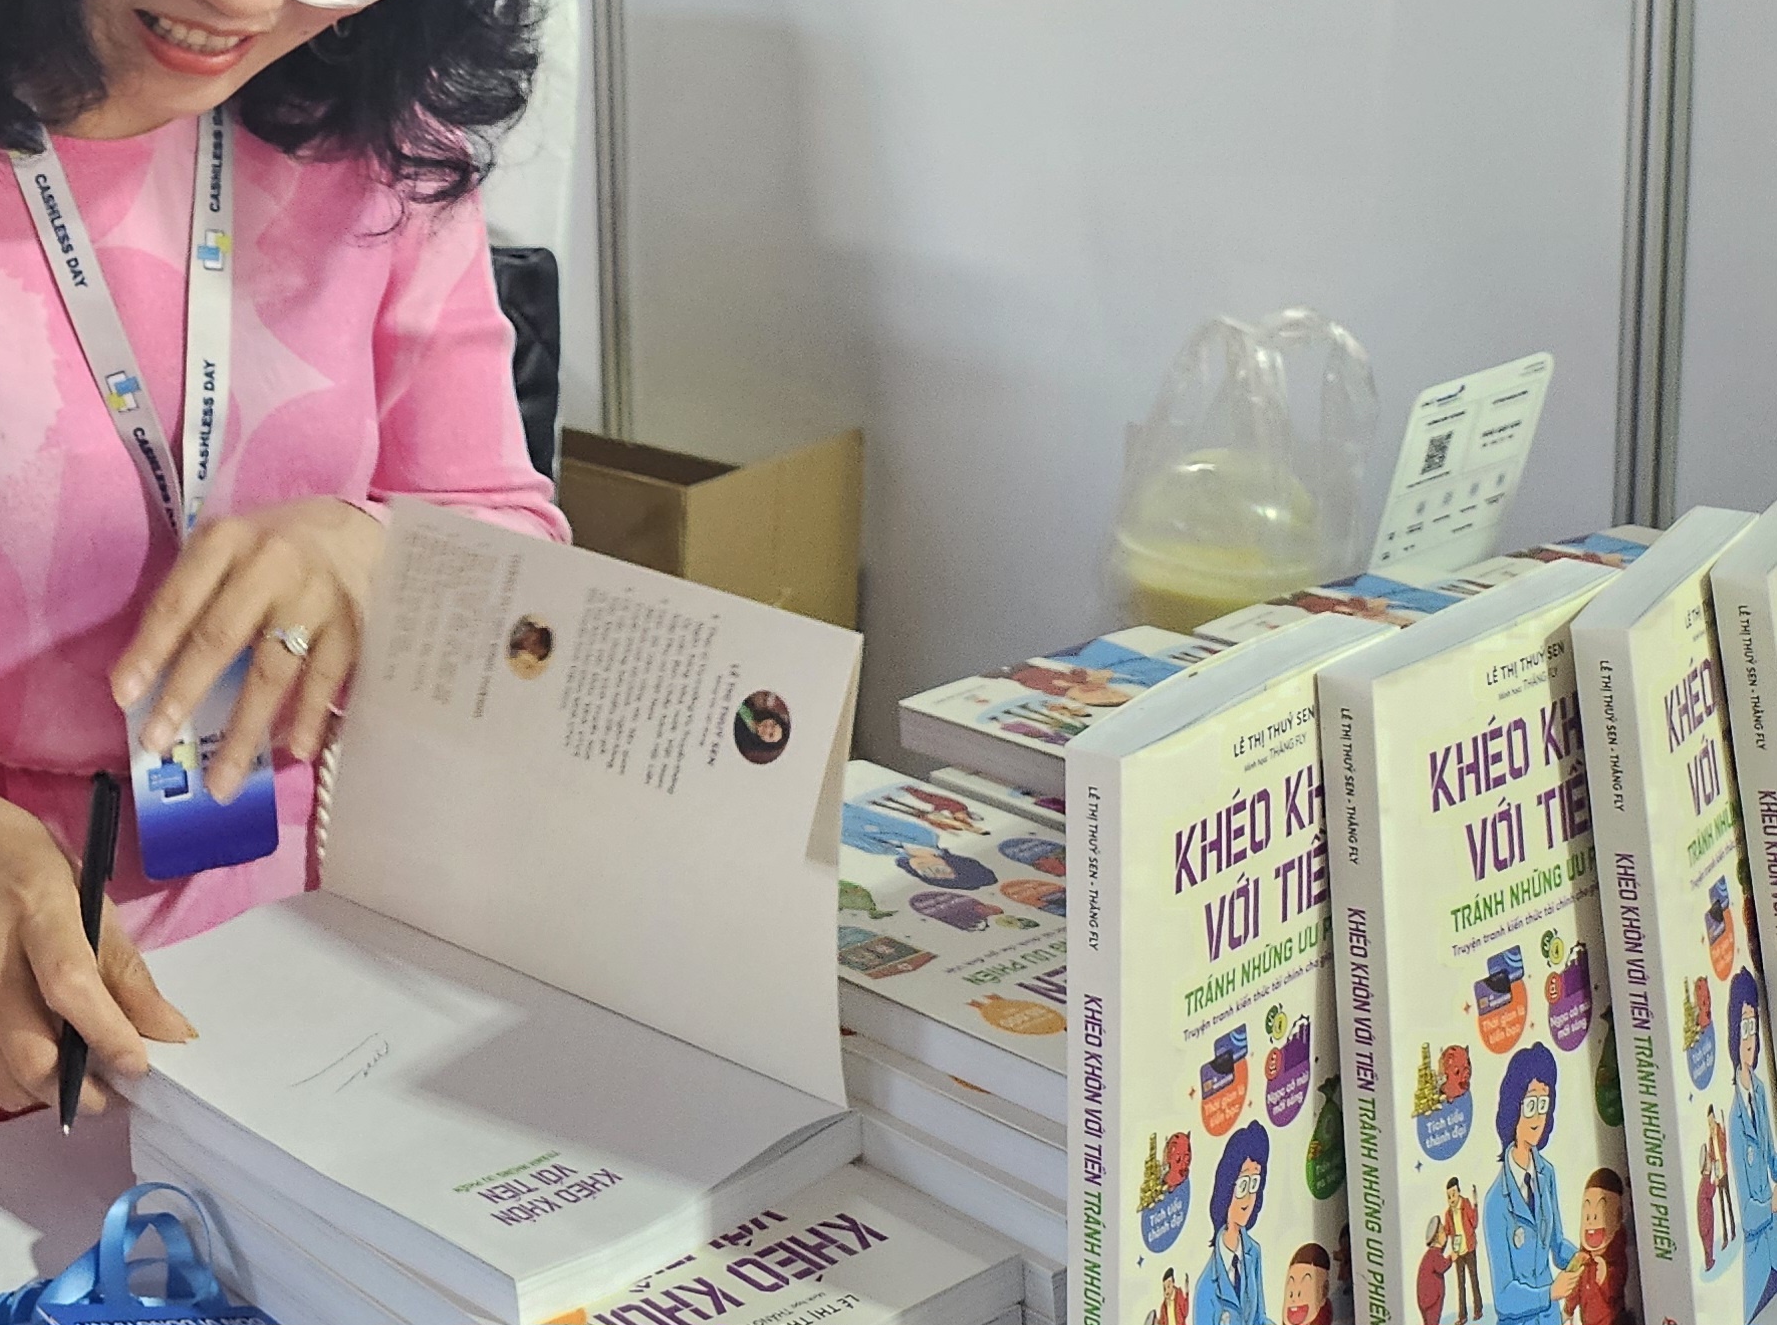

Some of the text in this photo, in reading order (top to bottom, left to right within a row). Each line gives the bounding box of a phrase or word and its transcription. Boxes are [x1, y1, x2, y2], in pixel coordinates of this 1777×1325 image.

[34, 173, 89, 287] CASHLESS DAY
[197, 358, 217, 481] CASHLESS DAY
[1486, 666, 1498, 685] LÊ
[1500, 662, 1518, 679] THỊ
[1547, 640, 1565, 660] SEN
[1600, 660, 1613, 672] LÊ
[1600, 675, 1613, 692] THỊ
[1340, 708, 1354, 720] LÊ
[1663, 657, 1717, 754] KHÉO
[1745, 667, 1758, 687] SEN
[1755, 732, 1768, 750] FLY
[1233, 736, 1245, 758] LÊ
[1247, 730, 1265, 751] THỊ
[1296, 705, 1315, 726] SEN
[1340, 723, 1352, 740] THỊ
[1429, 691, 1583, 813] KHÉO KH
[1606, 725, 1618, 745] SEN
[1087, 786, 1100, 799] LÊ
[1344, 775, 1355, 796] SEN
[1687, 734, 1721, 817] VỚI
[1086, 803, 1099, 820] THỊ
[1465, 759, 1591, 882] VỚI TIỀ
[1614, 793, 1626, 812] FLY
[1175, 764, 1326, 895] KHÉO KH
[1088, 857, 1099, 879] SEN
[1349, 846, 1359, 865] FLY
[1615, 853, 1640, 901] KHÉO
[1204, 827, 1329, 963] VỚI TIỀ
[1450, 889, 1505, 933] TRÁNH
[1510, 863, 1563, 909] NHỮNG
[1088, 935, 1099, 951] FLY
[1347, 907, 1371, 958] KHÉO
[1452, 937, 1481, 957] Truyện
[1483, 925, 1506, 944] tranh
[1508, 916, 1523, 933] kiến
[1620, 905, 1645, 954] KHÔN
[1184, 969, 1236, 1017] TRÁNH
[1241, 937, 1293, 987] NHỮNG
[1350, 961, 1374, 1013] KHÔN
[1626, 958, 1650, 985] VỚI
[1084, 994, 1106, 1048] KHÉO
[1183, 1020, 1211, 1042] Truyện
[1212, 1006, 1234, 1025] tranh
[1236, 994, 1252, 1012] kiến
[1354, 1018, 1376, 1046] VỚI
[1629, 990, 1654, 1031] TIỀN
[1084, 1050, 1106, 1105] KHÔN
[1355, 1051, 1379, 1093] TIỀN
[1633, 1036, 1660, 1097] TRÁNH
[1084, 1108, 1106, 1139] VỚI
[1358, 1097, 1382, 1161] TRÁNH
[1640, 1099, 1666, 1168] NHỮNG
[529, 1163, 578, 1186] VỚI
[553, 1168, 623, 1204] KHÉO
[1084, 1144, 1107, 1187] TIỀN
[477, 1178, 540, 1204] TIỀN
[490, 1195, 563, 1226] KHÔN
[1362, 1163, 1385, 1234] NHỮNG
[1084, 1190, 1106, 1258] TRÁNH
[1650, 1202, 1678, 1262] PHIỀN
[726, 1213, 889, 1292] KHÉO
[807, 1304, 841, 1321] THỊ
[836, 1293, 860, 1309] LÊ
